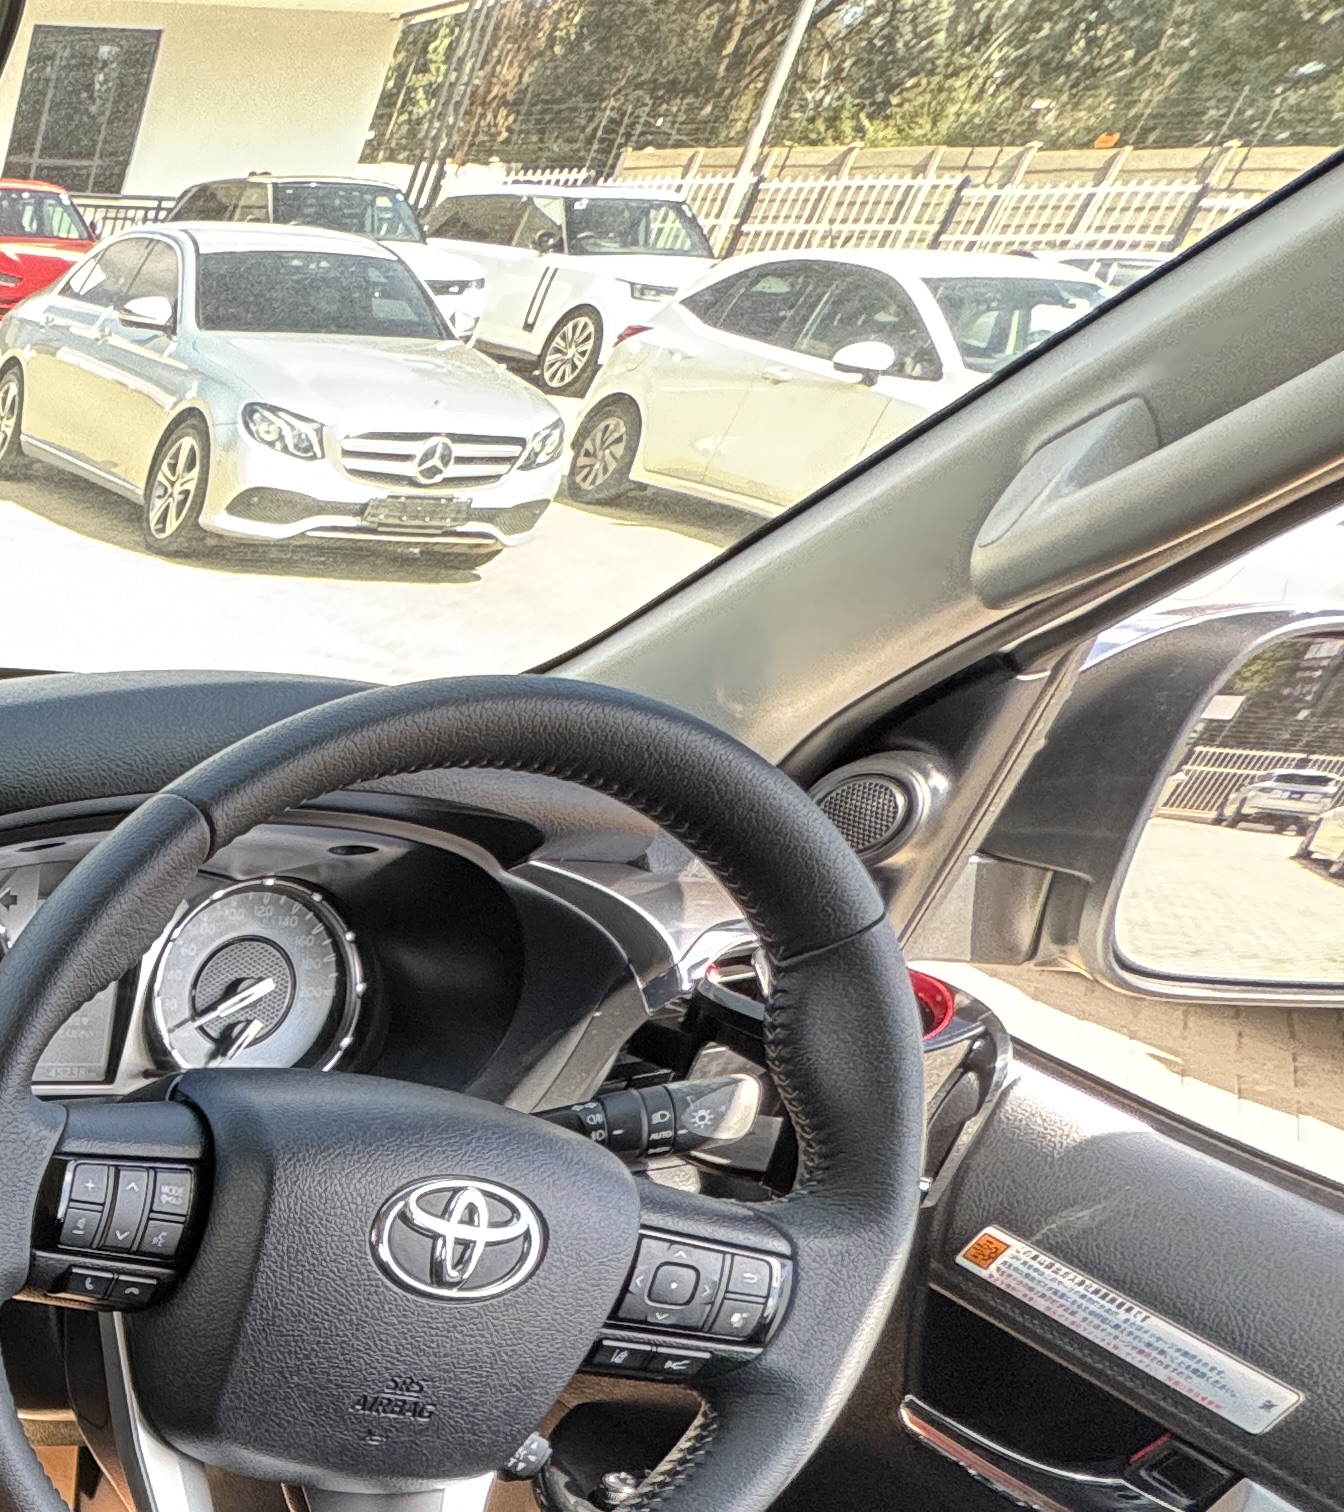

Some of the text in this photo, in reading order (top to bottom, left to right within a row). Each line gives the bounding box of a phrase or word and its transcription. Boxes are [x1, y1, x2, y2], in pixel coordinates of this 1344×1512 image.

[649, 1130, 673, 1141] AUTO
[161, 1184, 184, 1197] MODE
[350, 1394, 437, 1421] AIRBAG
